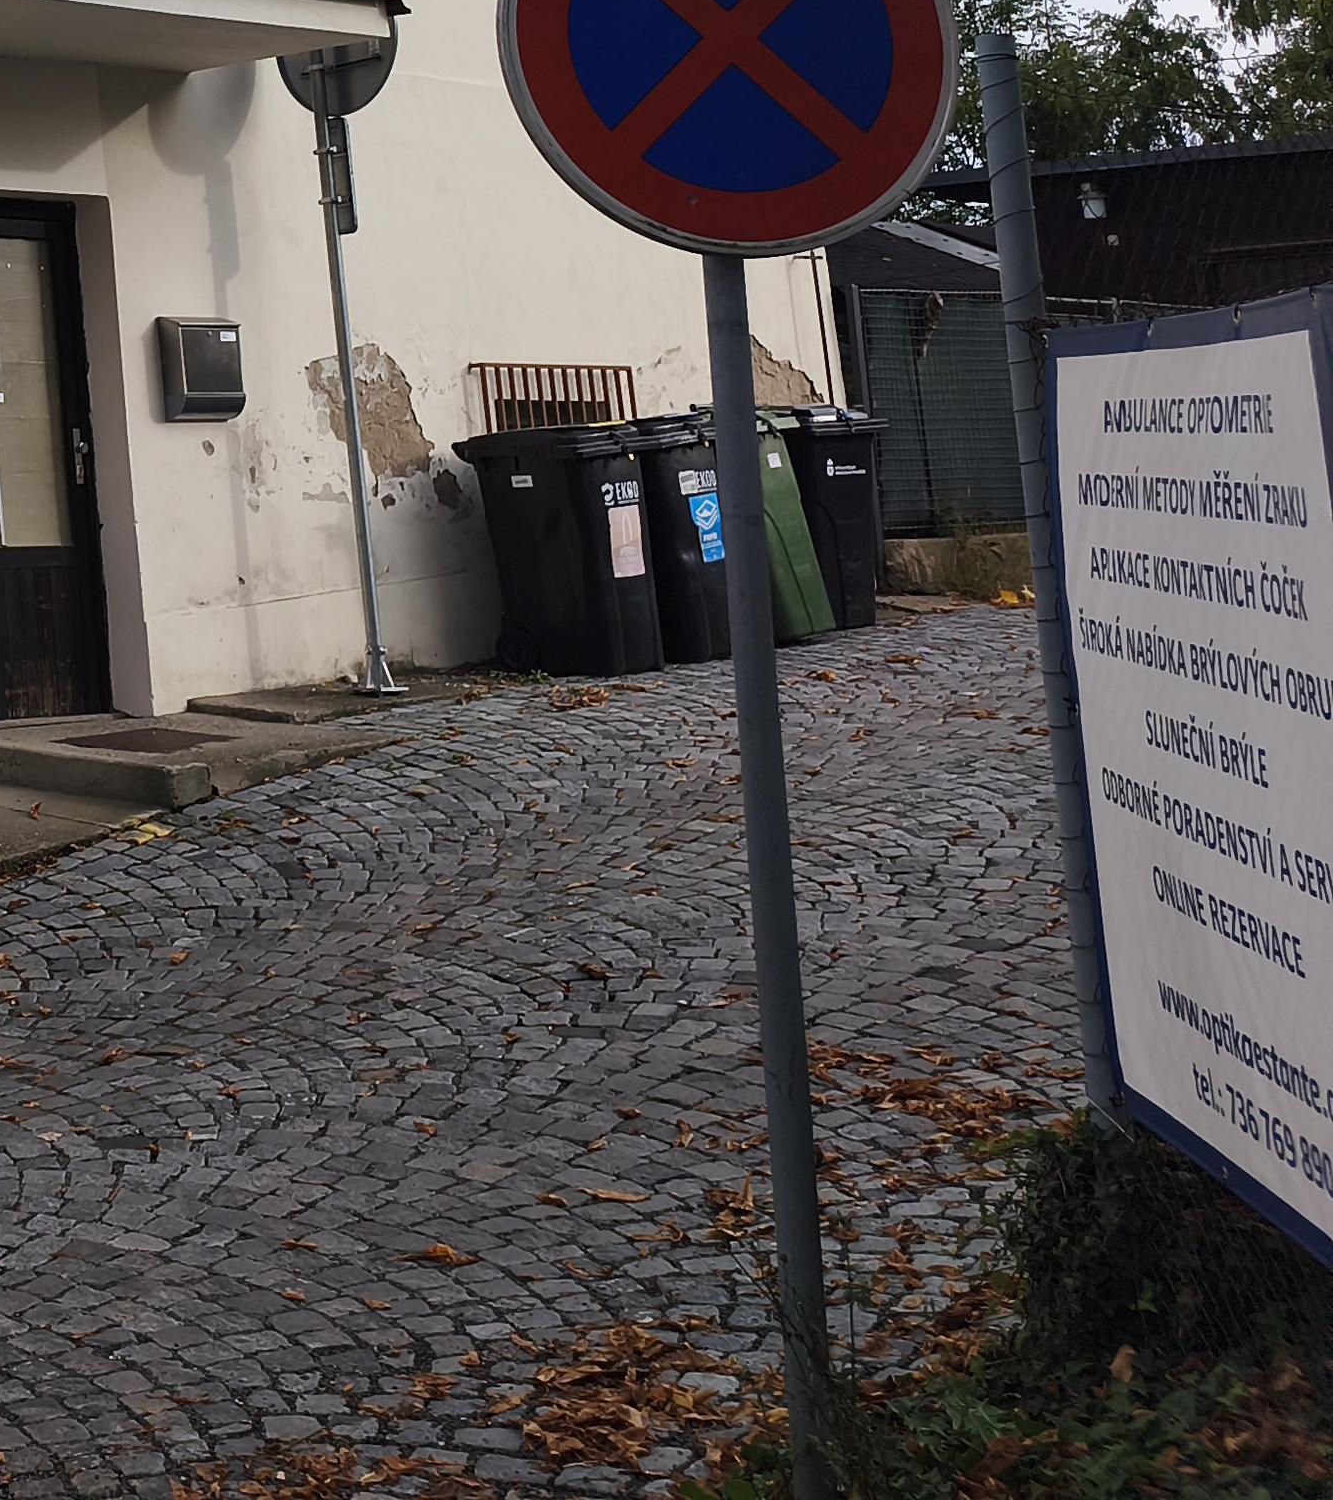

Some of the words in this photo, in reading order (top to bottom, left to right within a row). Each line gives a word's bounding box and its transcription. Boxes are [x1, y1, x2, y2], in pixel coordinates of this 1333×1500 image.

[1187, 394, 1274, 434] OPTOMETRIE
[1078, 465, 1140, 510] MODERNÍ
[1142, 475, 1196, 516] METODY
[1199, 469, 1262, 523] MĚŘENÍ
[1262, 484, 1309, 528] ZRAKU
[1090, 546, 1150, 589] APLIKACE
[1152, 556, 1257, 610] KONTAKTNÍCH
[1259, 560, 1309, 622] ČOČEK
[1079, 607, 1124, 660] ŠIROKÁ
[1126, 624, 1188, 678] NABÍDKA
[1189, 638, 1282, 705] BRÝLOVÝCH
[1285, 667, 1333, 721] OBRU
[1145, 709, 1217, 769] SLUNEČNÍ
[1219, 731, 1269, 789] BRÝLE
[1102, 766, 1162, 826] ODBORNÉ
[1163, 794, 1276, 878] PORADENSTVÍ
[1279, 843, 1294, 887] A
[1152, 865, 1208, 927] ONLINE
[1208, 893, 1307, 979] REZERVACE
[1192, 1062, 1226, 1118] tel.:
[1225, 1083, 1260, 1142] 736
[1258, 1107, 1297, 1169] 769
[1299, 1135, 1333, 1200] 890
